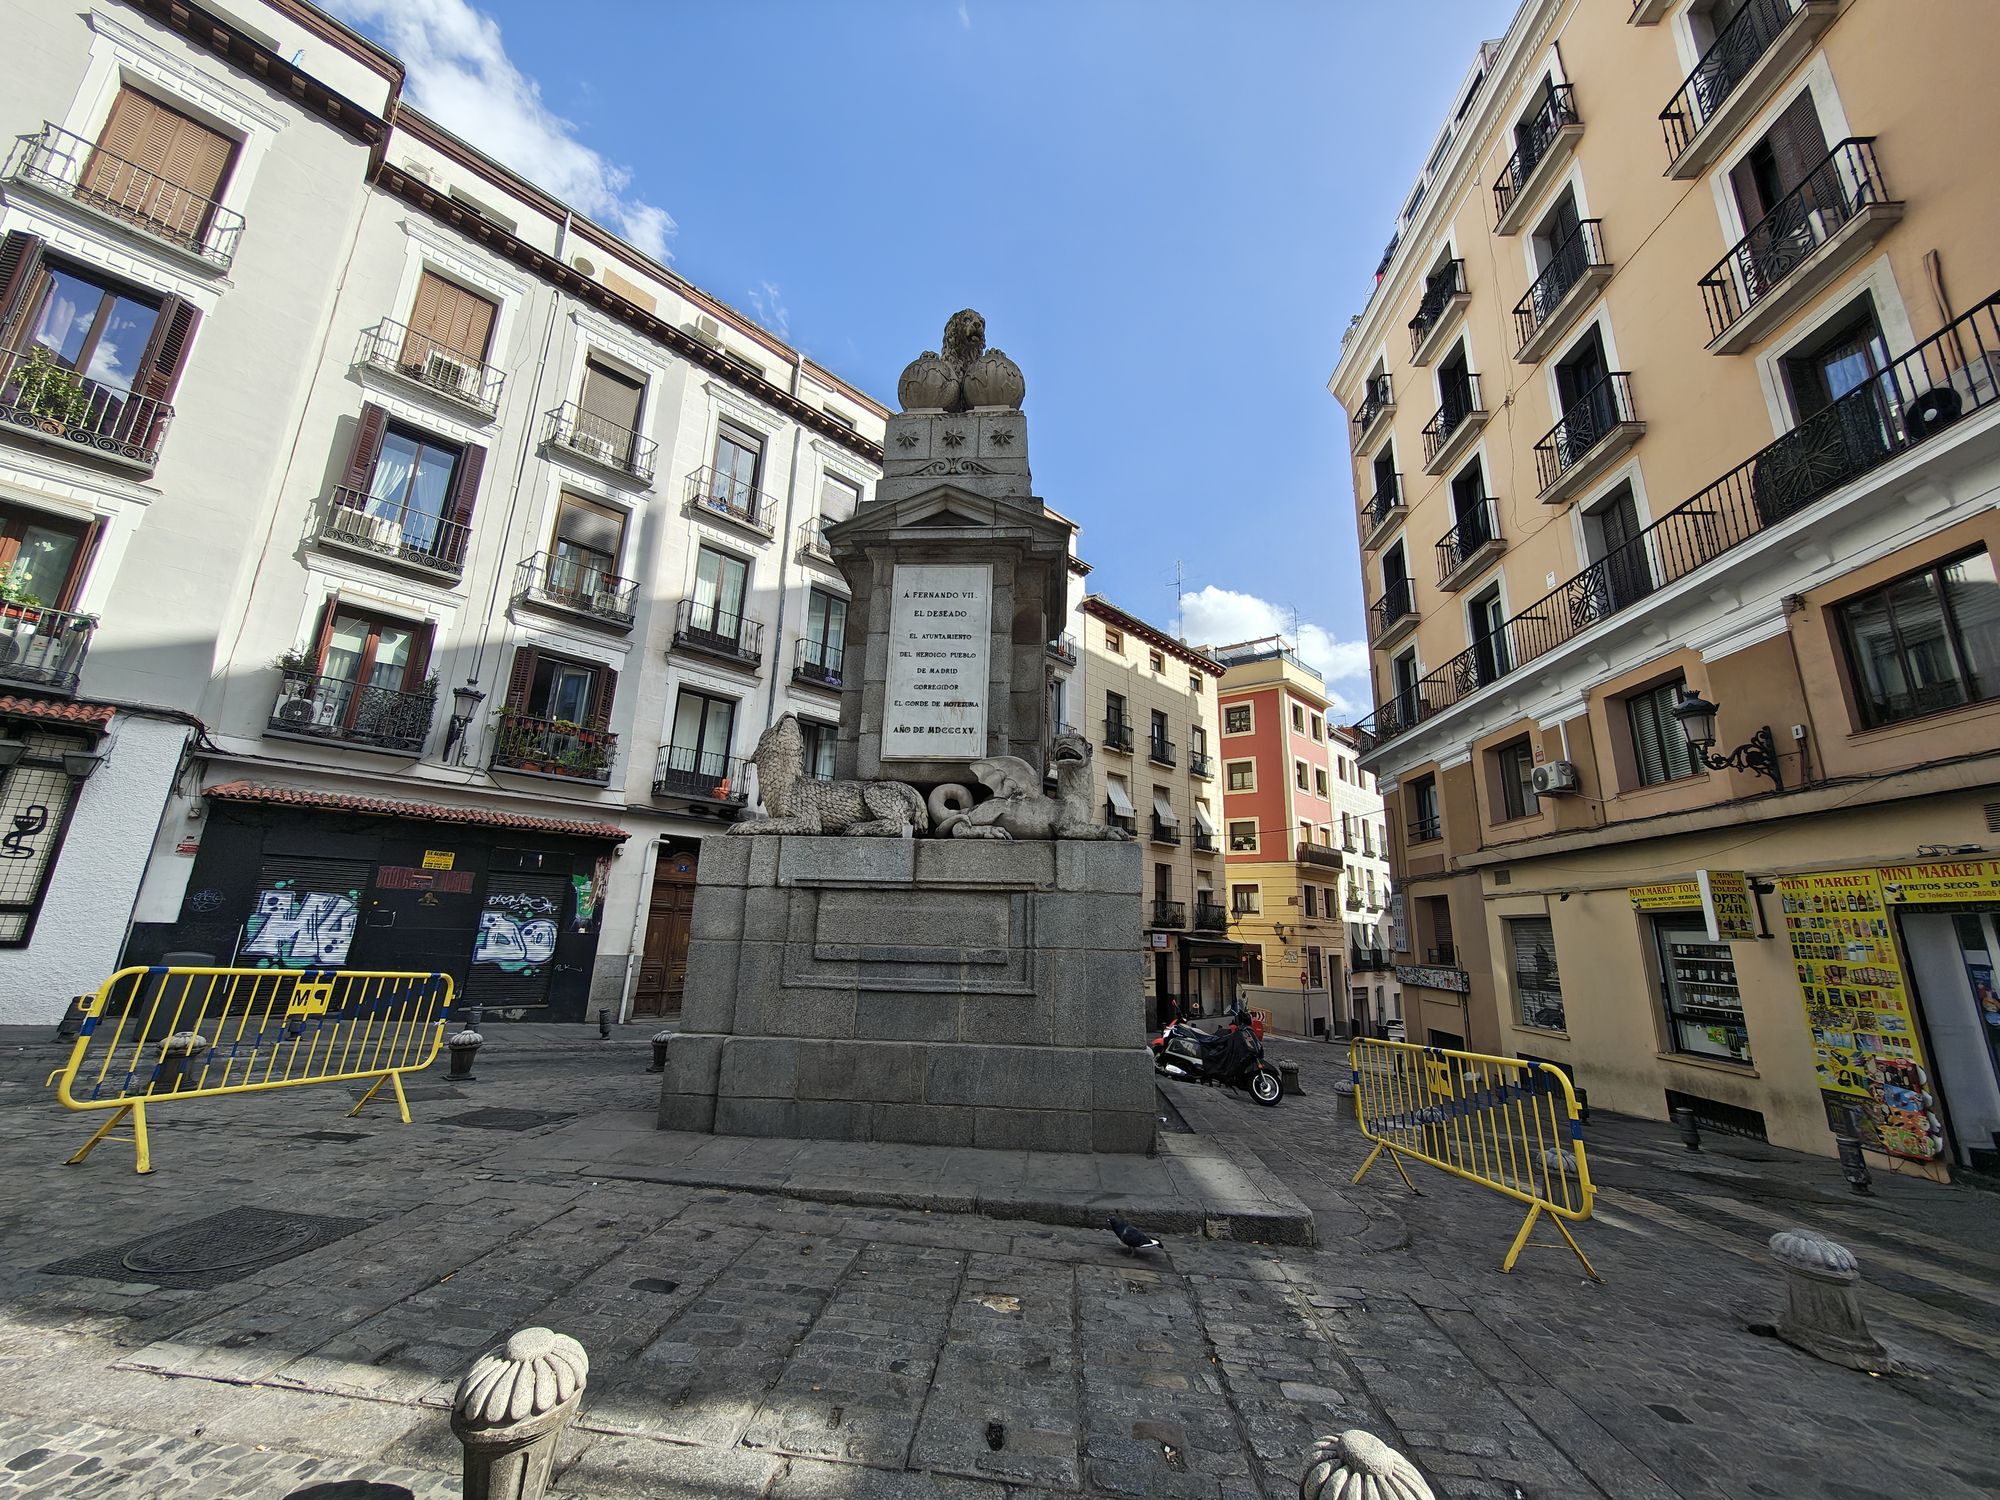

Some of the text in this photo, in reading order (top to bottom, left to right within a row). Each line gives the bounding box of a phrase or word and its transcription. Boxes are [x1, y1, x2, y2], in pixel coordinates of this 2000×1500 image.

[913, 591, 959, 599] FERNANDO
[927, 610, 967, 618] DESEADO
[893, 725, 911, 734] AÑO
[913, 726, 924, 734] DE
[1880, 867, 1912, 881] MINI
[1916, 862, 1984, 879] MARKET
[1781, 874, 1871, 890] MINI MARKET
[1903, 883, 1941, 891] FRUTOS
[1943, 881, 1980, 890] SECOS
[1629, 888, 1645, 898] MINI
[1647, 885, 1676, 896] MARKET
[1928, 891, 1953, 899] Toledo
[1712, 893, 1747, 905] OPEN
[1717, 903, 1749, 914] 24H.
